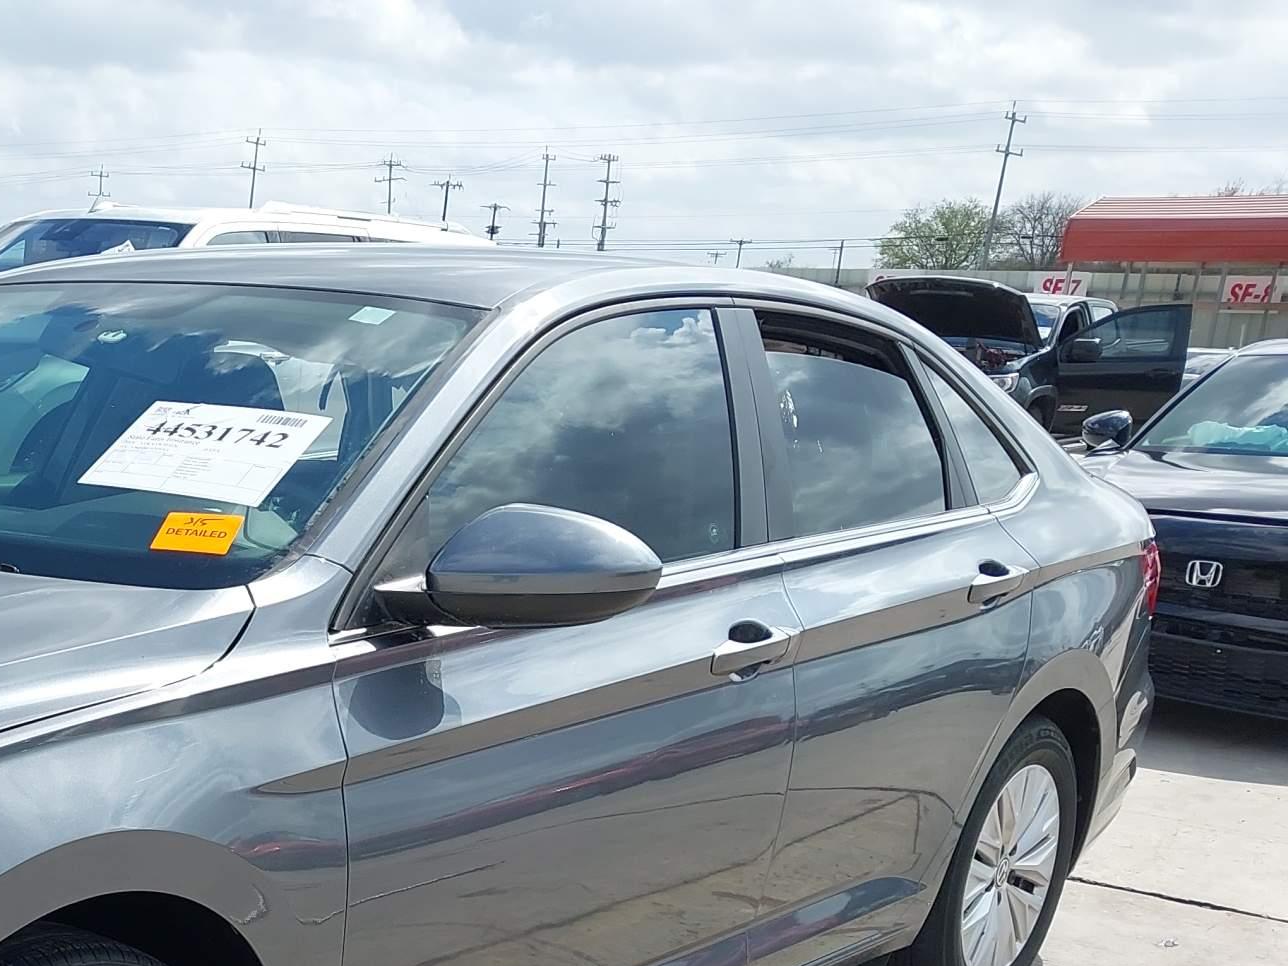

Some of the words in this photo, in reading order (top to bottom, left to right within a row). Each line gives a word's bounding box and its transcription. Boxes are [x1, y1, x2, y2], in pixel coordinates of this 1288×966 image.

[1043, 278, 1082, 295] SF7
[145, 420, 289, 449] 44531742
[165, 527, 228, 539] DETAILED
